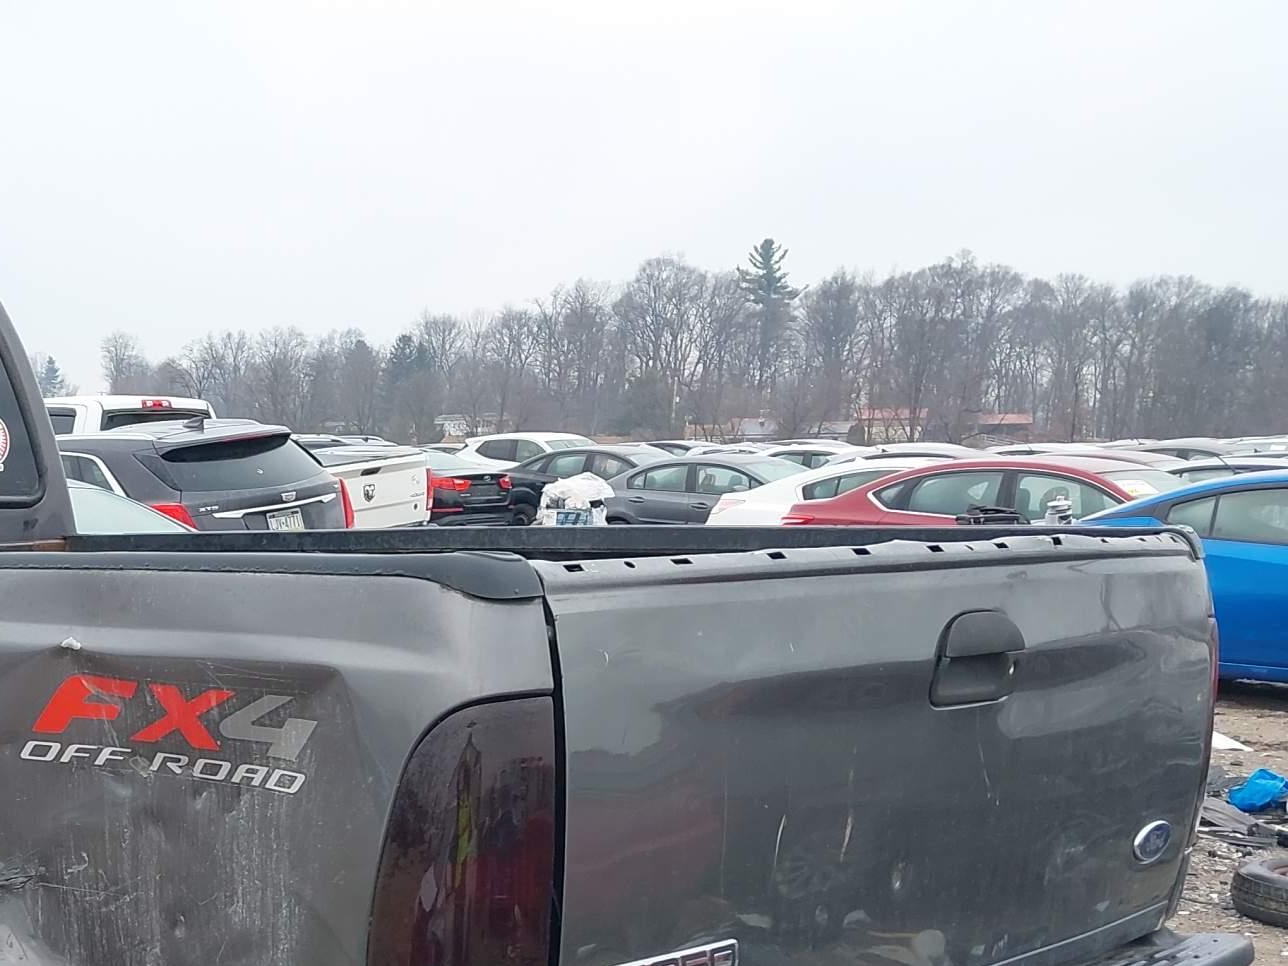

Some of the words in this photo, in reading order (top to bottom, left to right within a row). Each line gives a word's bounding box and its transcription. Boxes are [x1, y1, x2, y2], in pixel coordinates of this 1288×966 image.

[31, 674, 318, 761] FX4
[19, 740, 132, 766] OFF
[149, 752, 306, 794] ROAD
